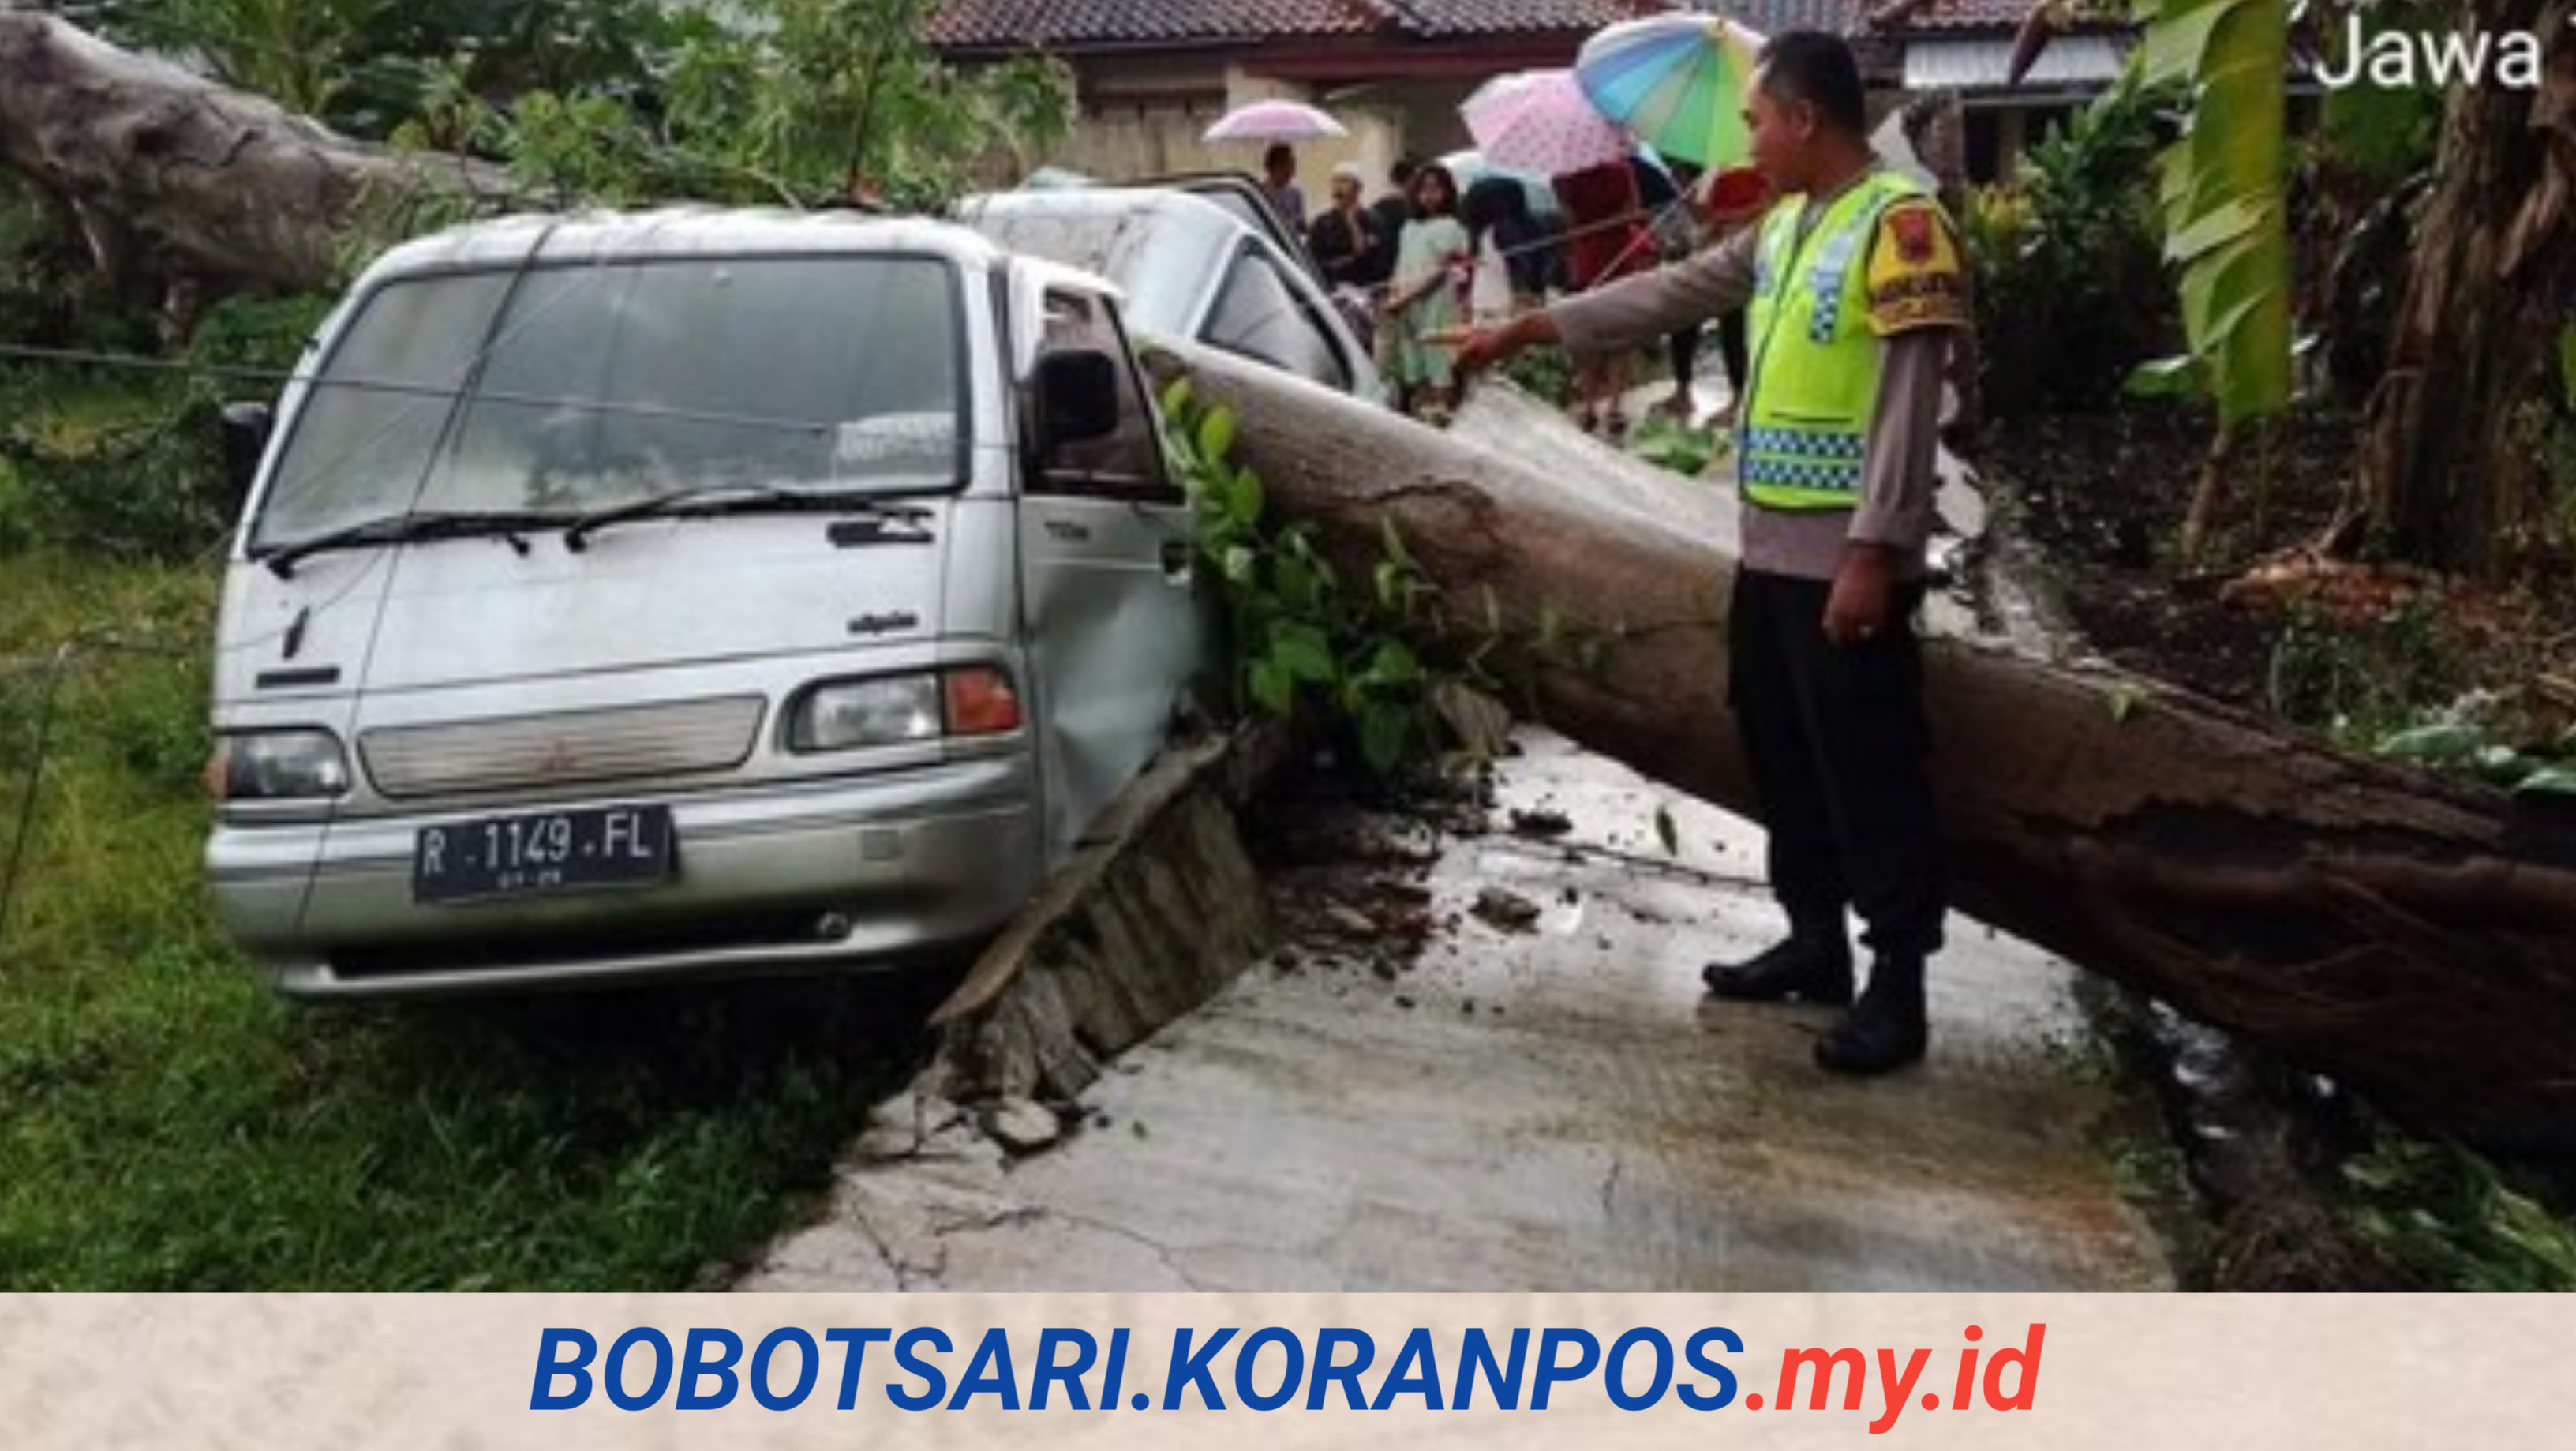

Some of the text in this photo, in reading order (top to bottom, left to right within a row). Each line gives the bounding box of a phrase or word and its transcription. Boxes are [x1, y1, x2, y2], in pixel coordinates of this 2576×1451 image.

[423, 811, 652, 875] R 1149 FL
